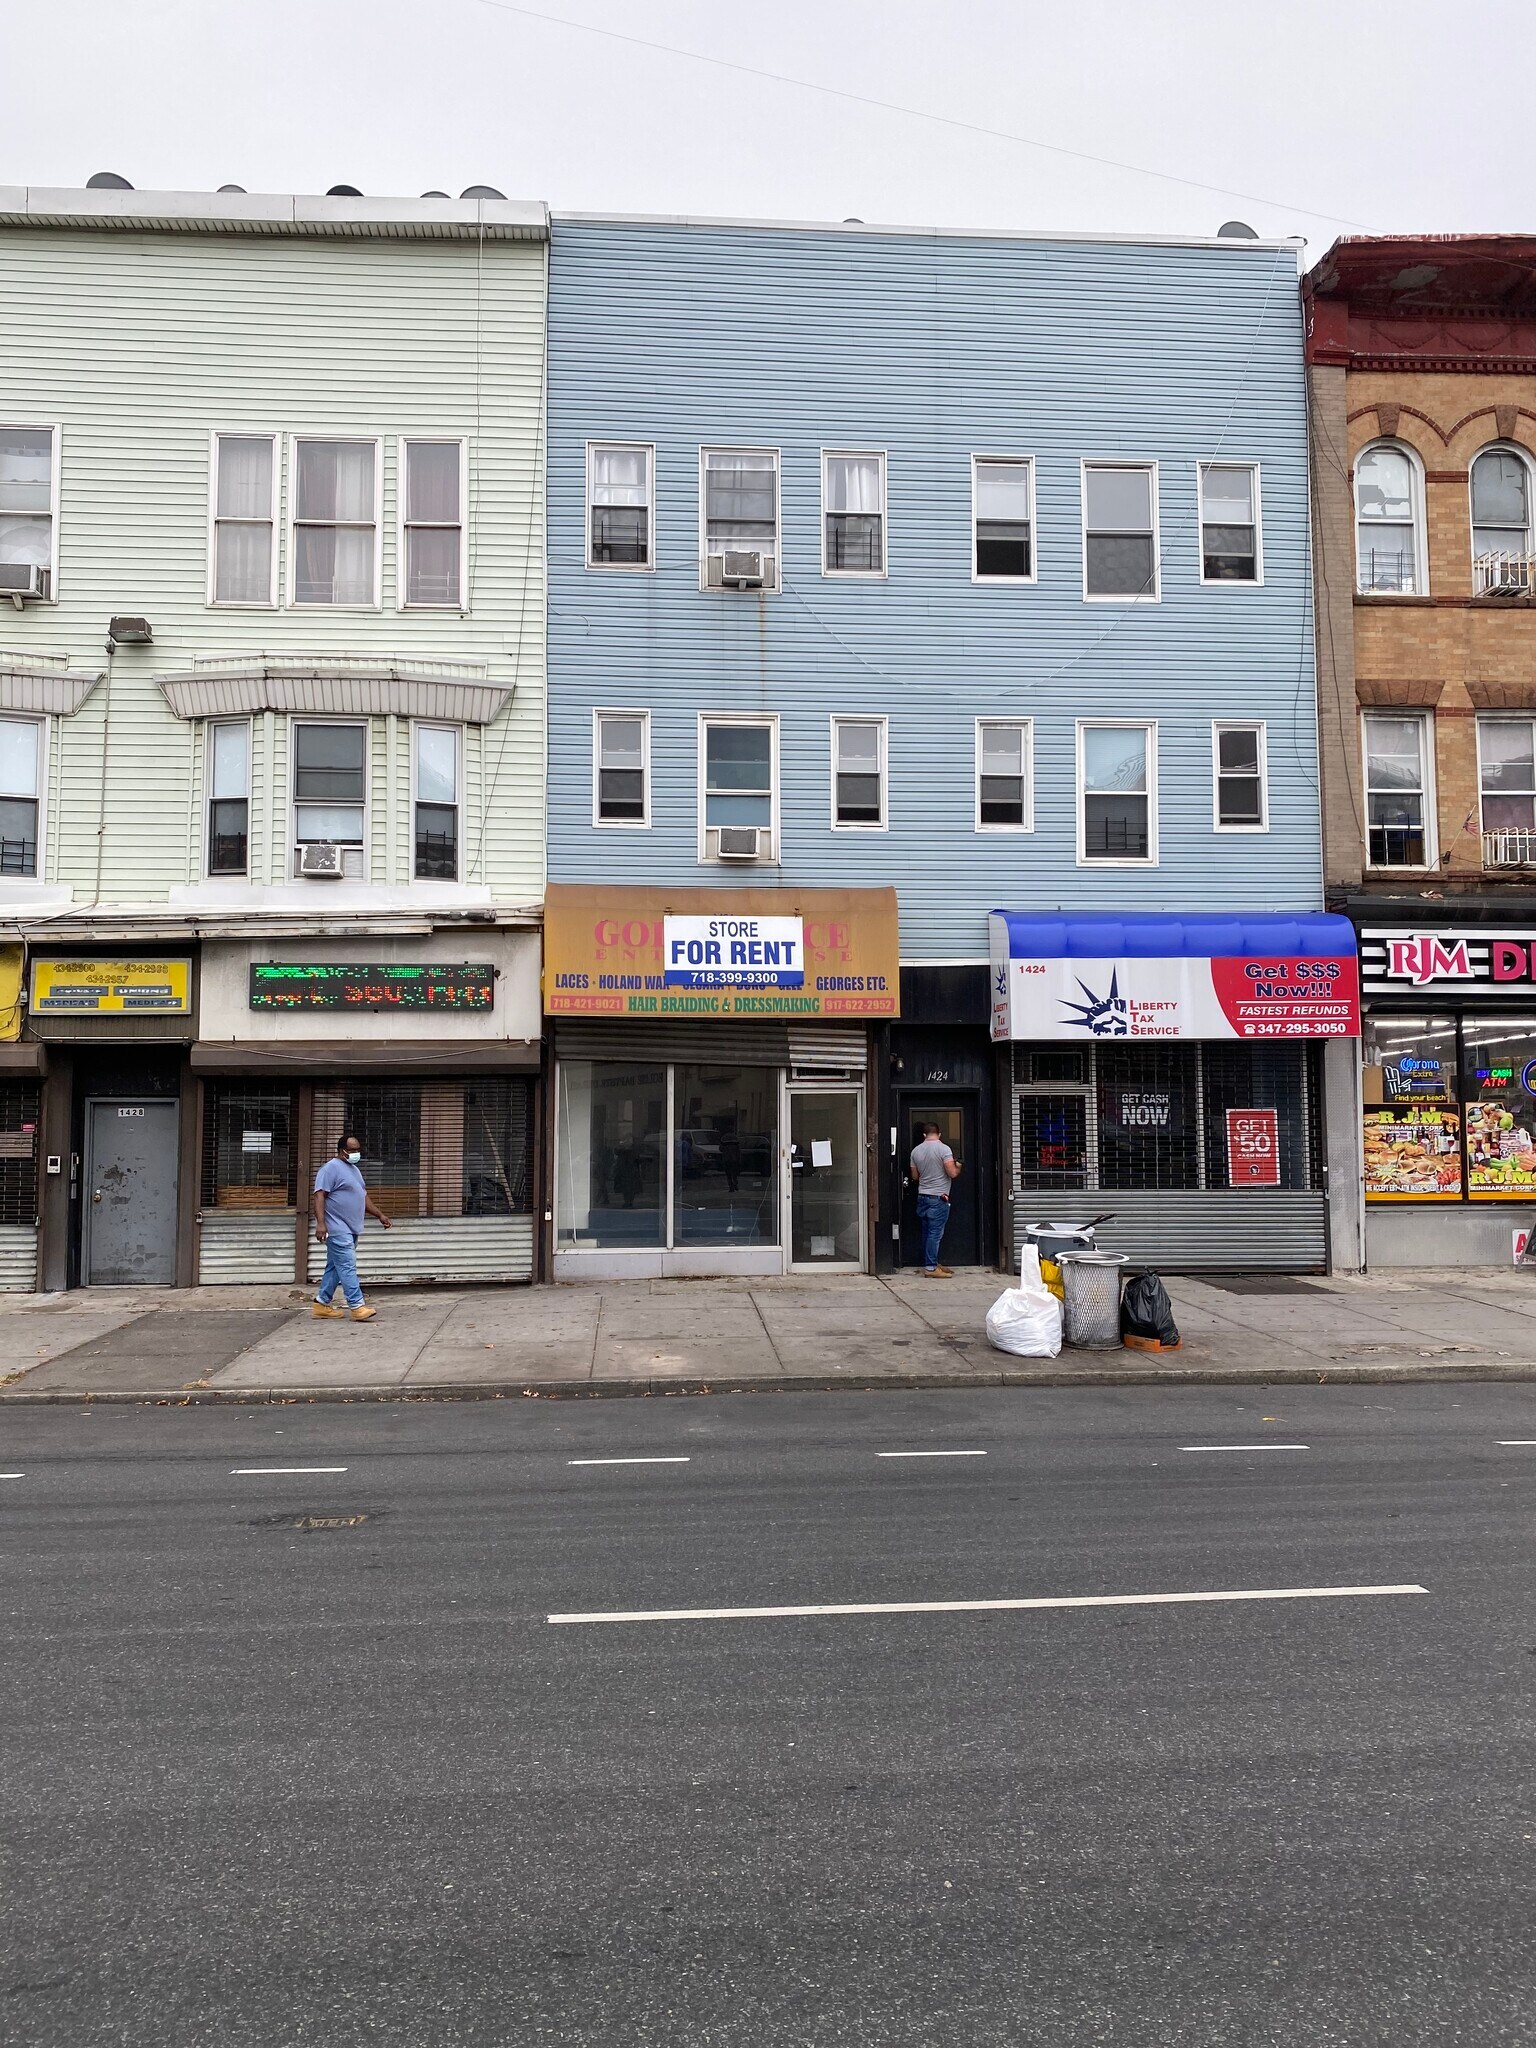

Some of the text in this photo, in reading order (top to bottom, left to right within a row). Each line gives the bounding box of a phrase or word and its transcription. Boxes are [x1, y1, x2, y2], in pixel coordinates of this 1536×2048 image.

[709, 921, 758, 937] STORE
[671, 940, 796, 965] FOR RENT
[1389, 937, 1470, 982] RJM
[1019, 965, 1046, 974] 1424
[1245, 962, 1340, 980] Get $$$
[555, 974, 589, 989] LACES
[599, 975, 642, 990] HOLAND
[816, 976, 864, 991] GEORGES
[866, 977, 889, 991] ETC.
[690, 972, 778, 983] 718-399-9300
[1255, 982, 1332, 997] Now!!!
[553, 996, 892, 1013] 718-421-9021 HAIR BRAIDING & DRESSMAKING 917-622-2952
[993, 1003, 1009, 1013] LIBERTY
[1129, 1000, 1178, 1010] LIBERTY
[1240, 1006, 1349, 1015] FASTEST REFUNDS
[1130, 1012, 1154, 1022] TAX
[993, 1027, 1009, 1038] SERVICE
[1130, 1025, 1180, 1035] SERVICE
[1257, 1023, 1346, 1034] 347-295-3050
[1400, 1058, 1440, 1071] Corona
[927, 1071, 948, 1081] 1424
[1491, 1069, 1512, 1078] CASH
[1482, 1078, 1507, 1088] ATM
[1122, 1094, 1169, 1104] GET CASH
[1411, 1095, 1425, 1103] your
[1122, 1106, 1170, 1125] NOW
[1236, 1119, 1270, 1133] GET
[1233, 1133, 1271, 1152] $50
